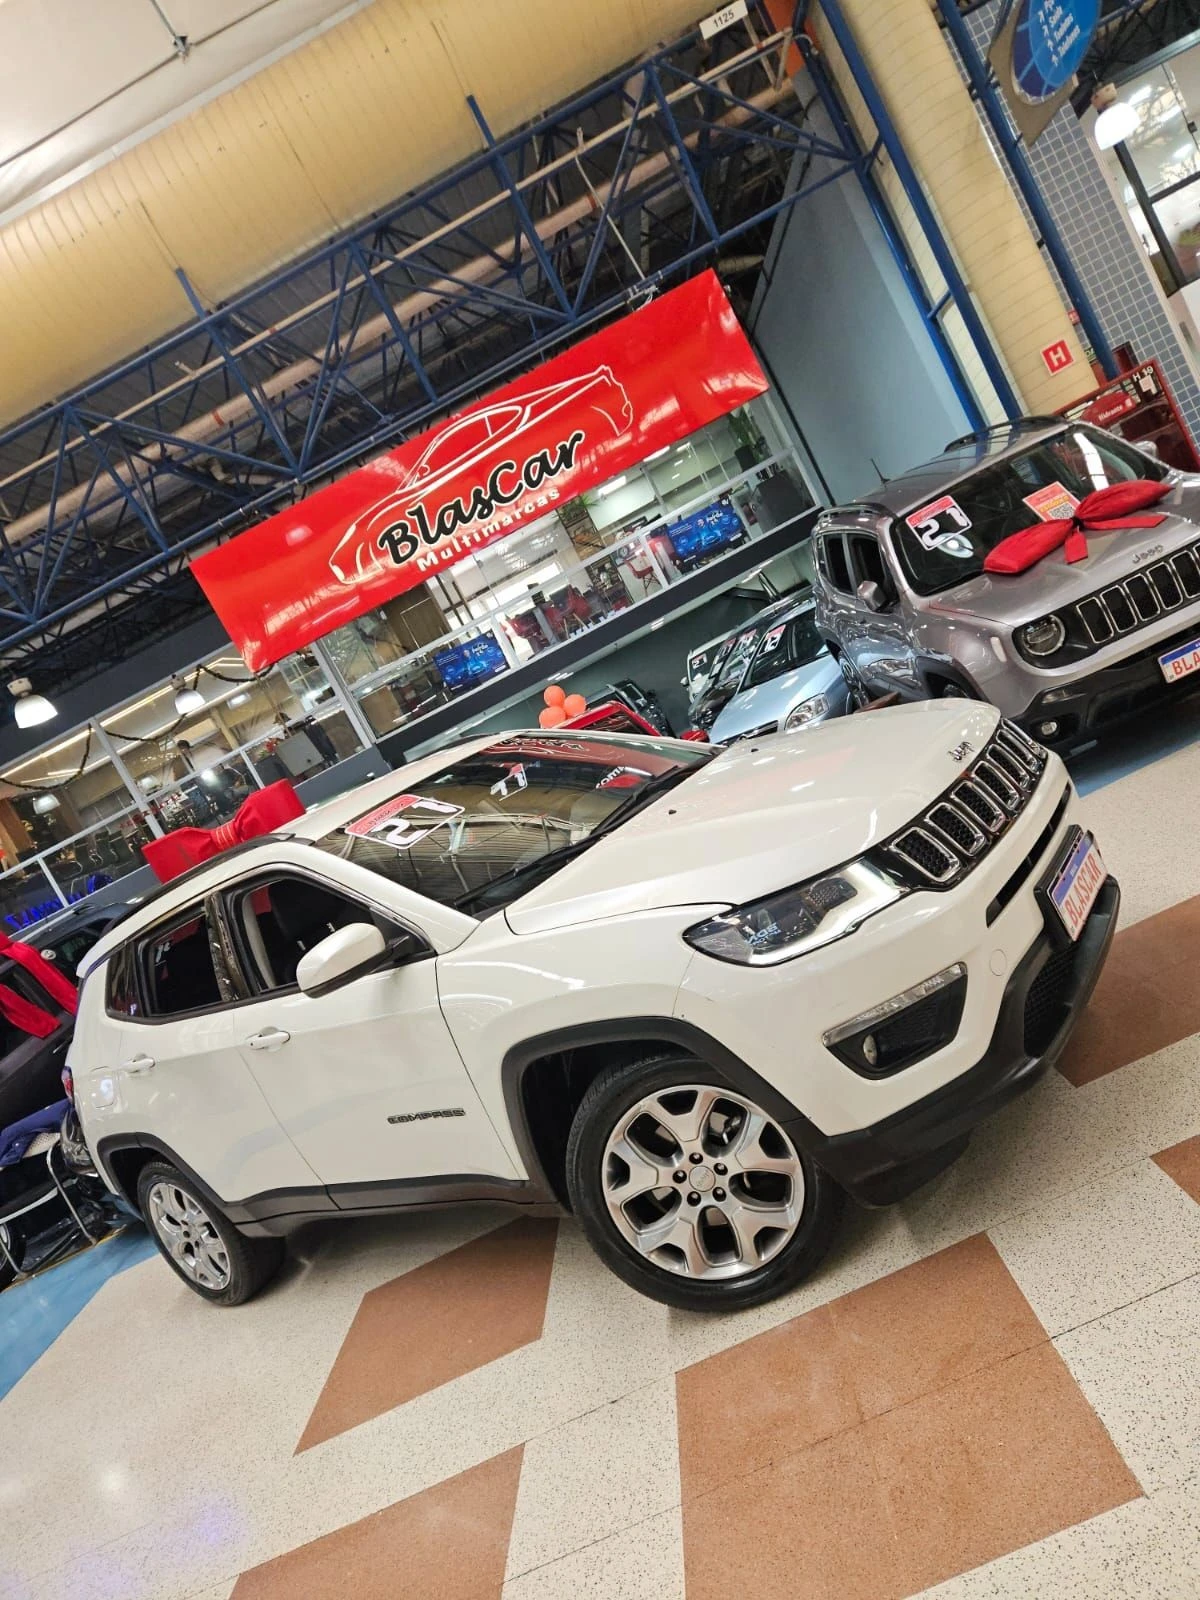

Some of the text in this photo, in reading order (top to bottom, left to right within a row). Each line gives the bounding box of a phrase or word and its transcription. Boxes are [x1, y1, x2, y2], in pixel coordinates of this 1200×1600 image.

[713, 9, 735, 28] 1125
[1049, 345, 1067, 367] H
[1132, 371, 1141, 383] H
[377, 430, 585, 566] BlasCar
[415, 487, 561, 572] Multimarcas
[918, 506, 968, 548] 21
[1131, 544, 1165, 565] Jeep
[371, 798, 459, 846] 21
[1064, 853, 1101, 928] BLASCAR
[387, 1107, 466, 1126] COMPASS
